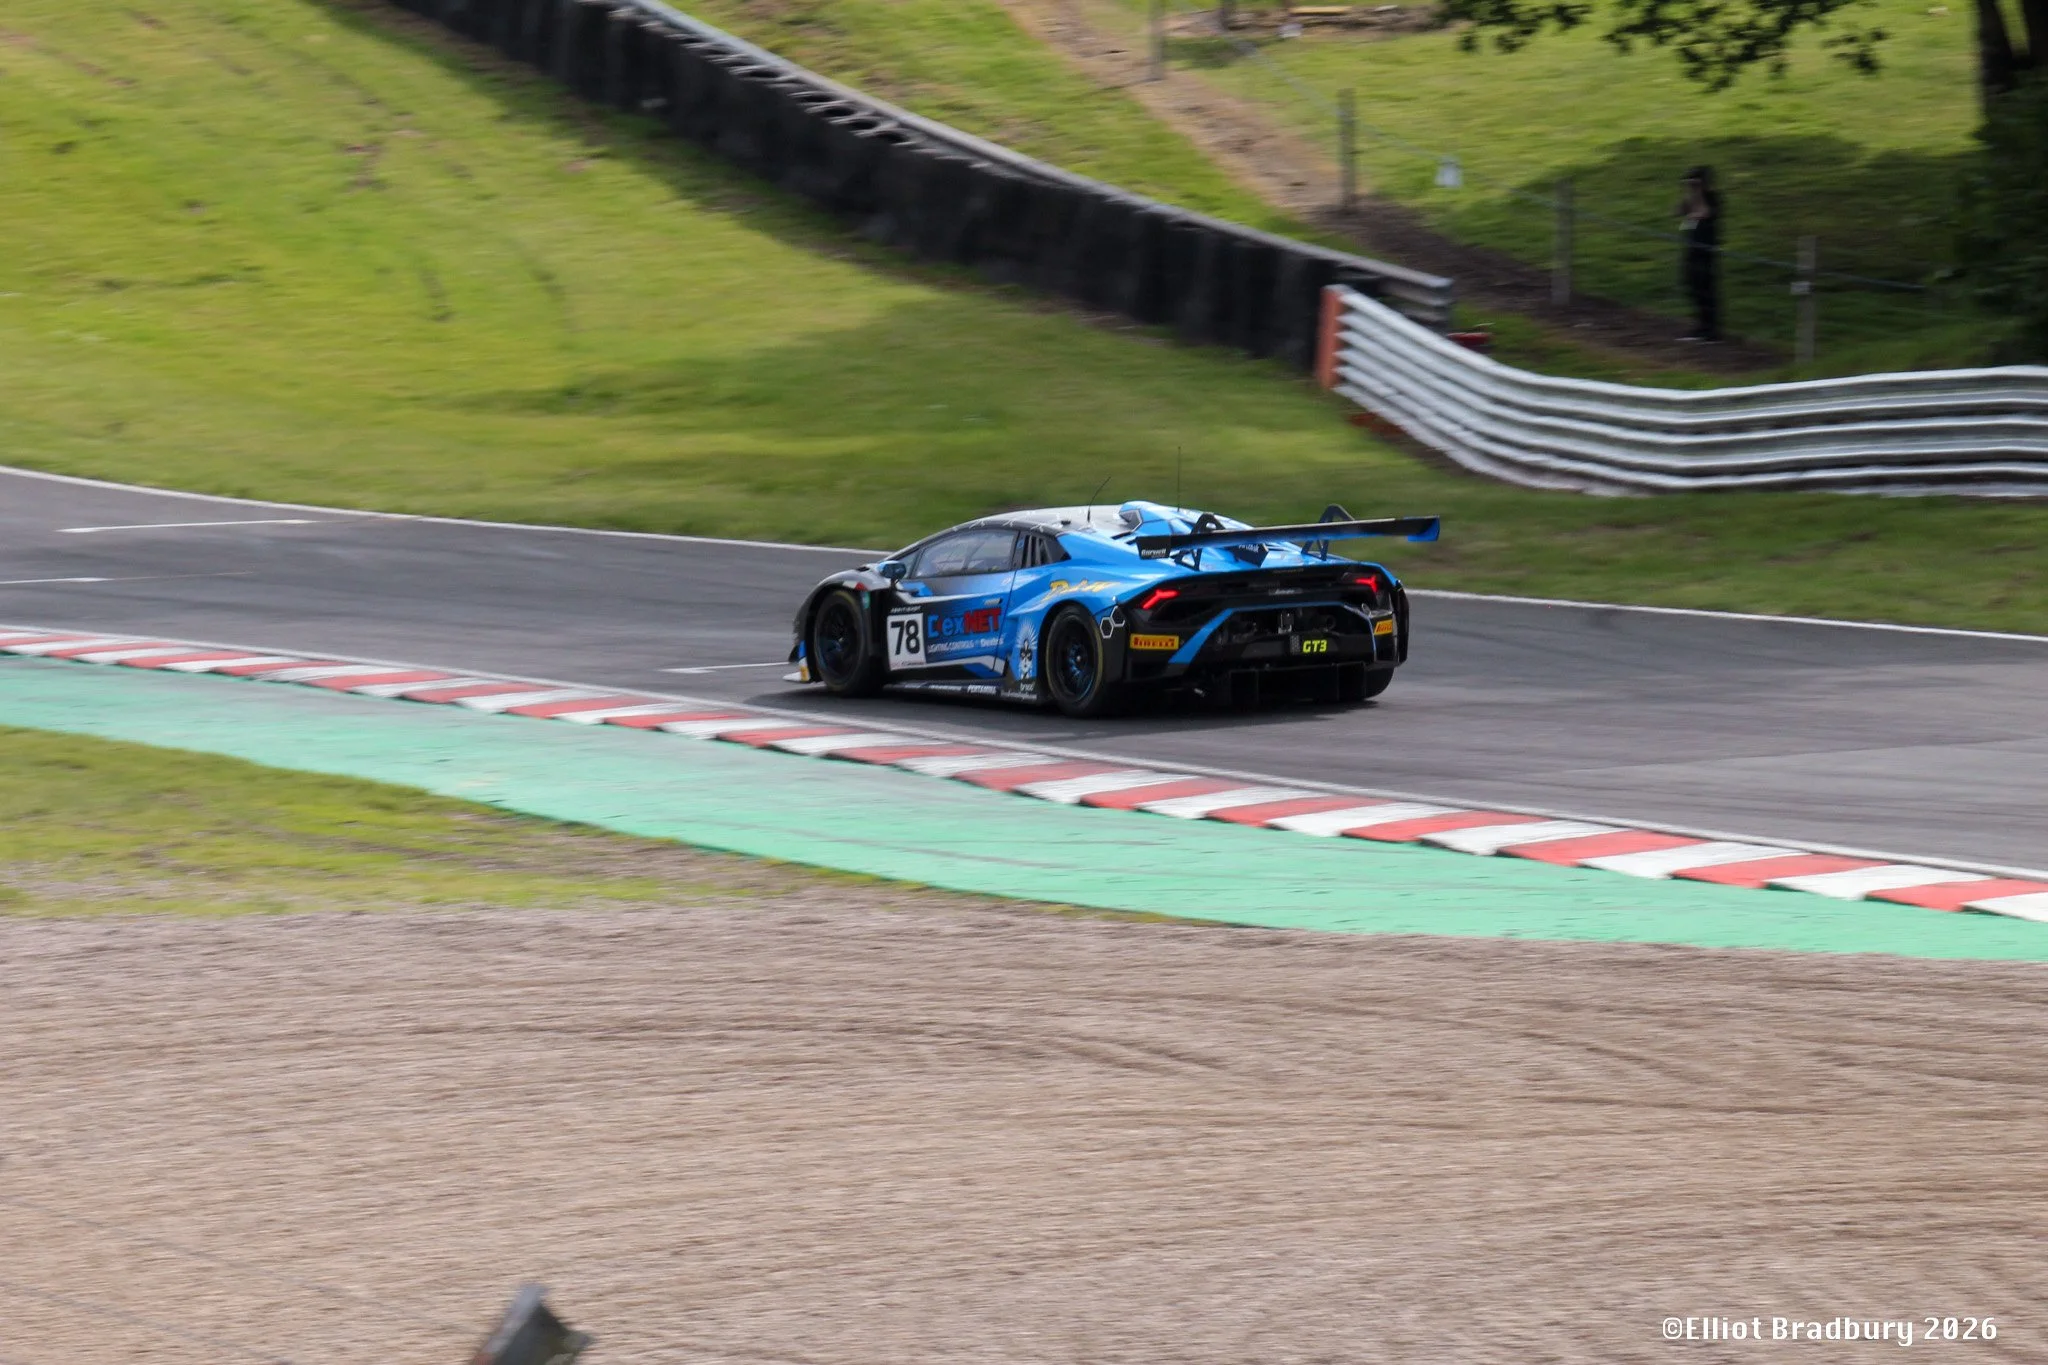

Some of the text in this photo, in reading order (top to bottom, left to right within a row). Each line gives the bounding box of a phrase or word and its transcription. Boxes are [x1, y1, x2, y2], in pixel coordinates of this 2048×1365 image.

[890, 619, 920, 655] 78
[1133, 636, 1175, 647] PIRELLI
[1302, 640, 1327, 653] GT3
